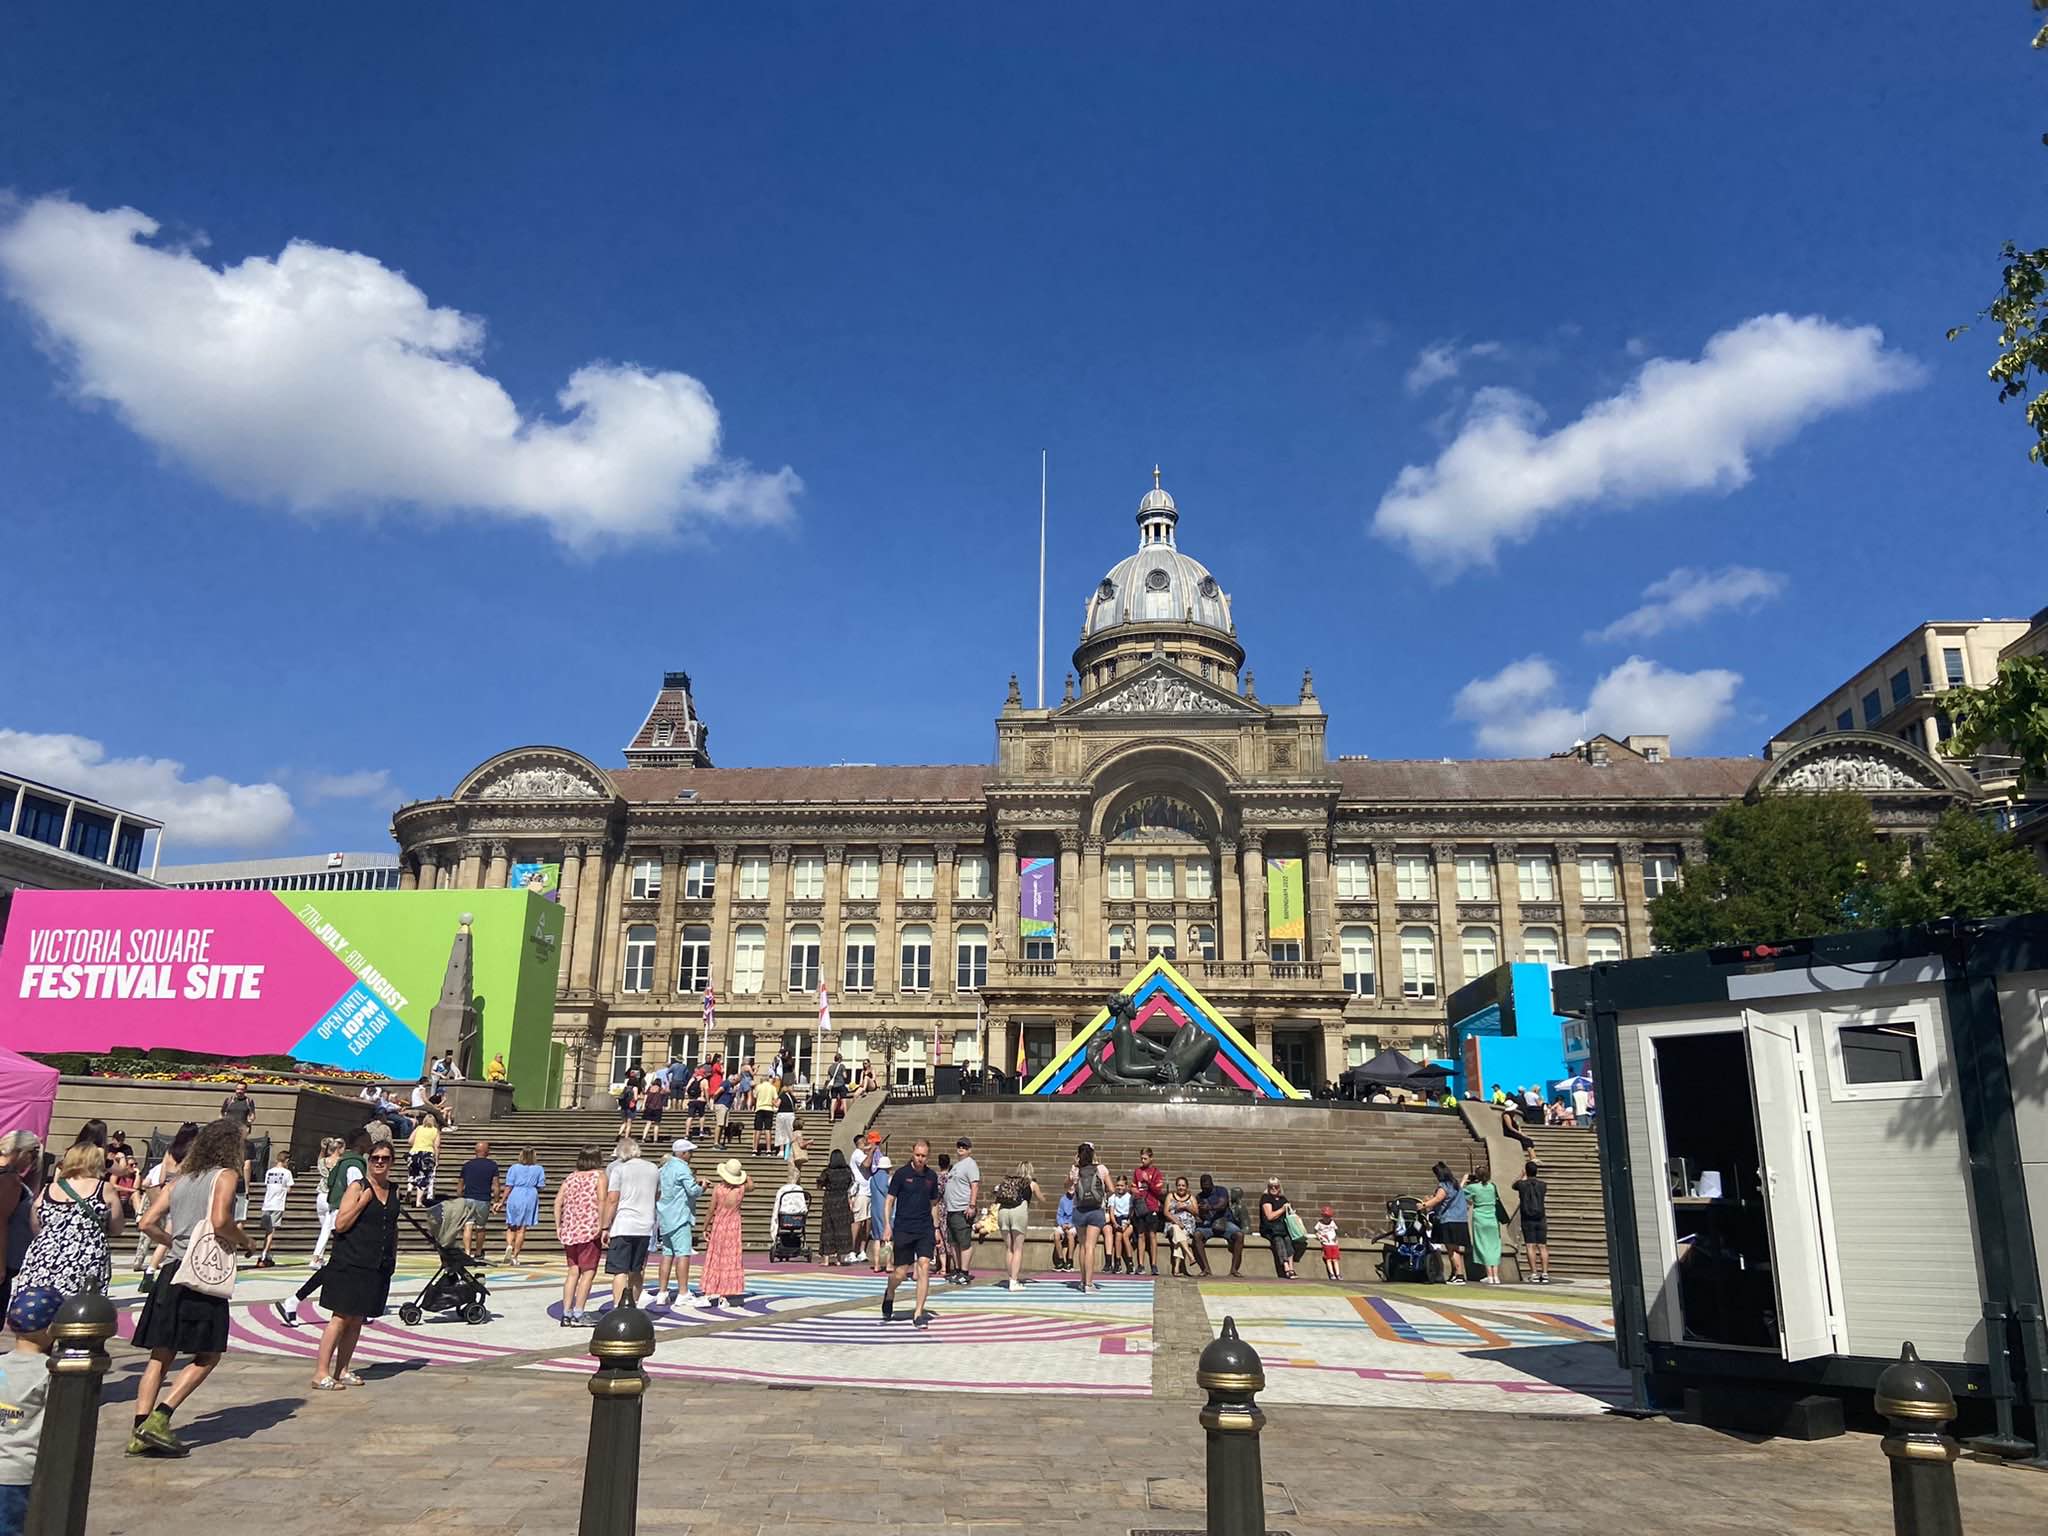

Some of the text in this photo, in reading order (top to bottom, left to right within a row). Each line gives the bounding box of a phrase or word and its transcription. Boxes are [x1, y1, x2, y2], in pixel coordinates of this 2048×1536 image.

[29, 928, 214, 963] VICTORIA SQUARE
[298, 903, 323, 928] 27TH
[315, 923, 350, 952] JULY
[345, 950, 367, 971] 8TH
[359, 964, 409, 1012] AUGUST
[19, 964, 265, 999] FESTIVAL SITE
[317, 989, 368, 1040] OPEN UNTIL
[341, 999, 380, 1039] 10PM
[347, 1011, 391, 1056] EACH DAY
